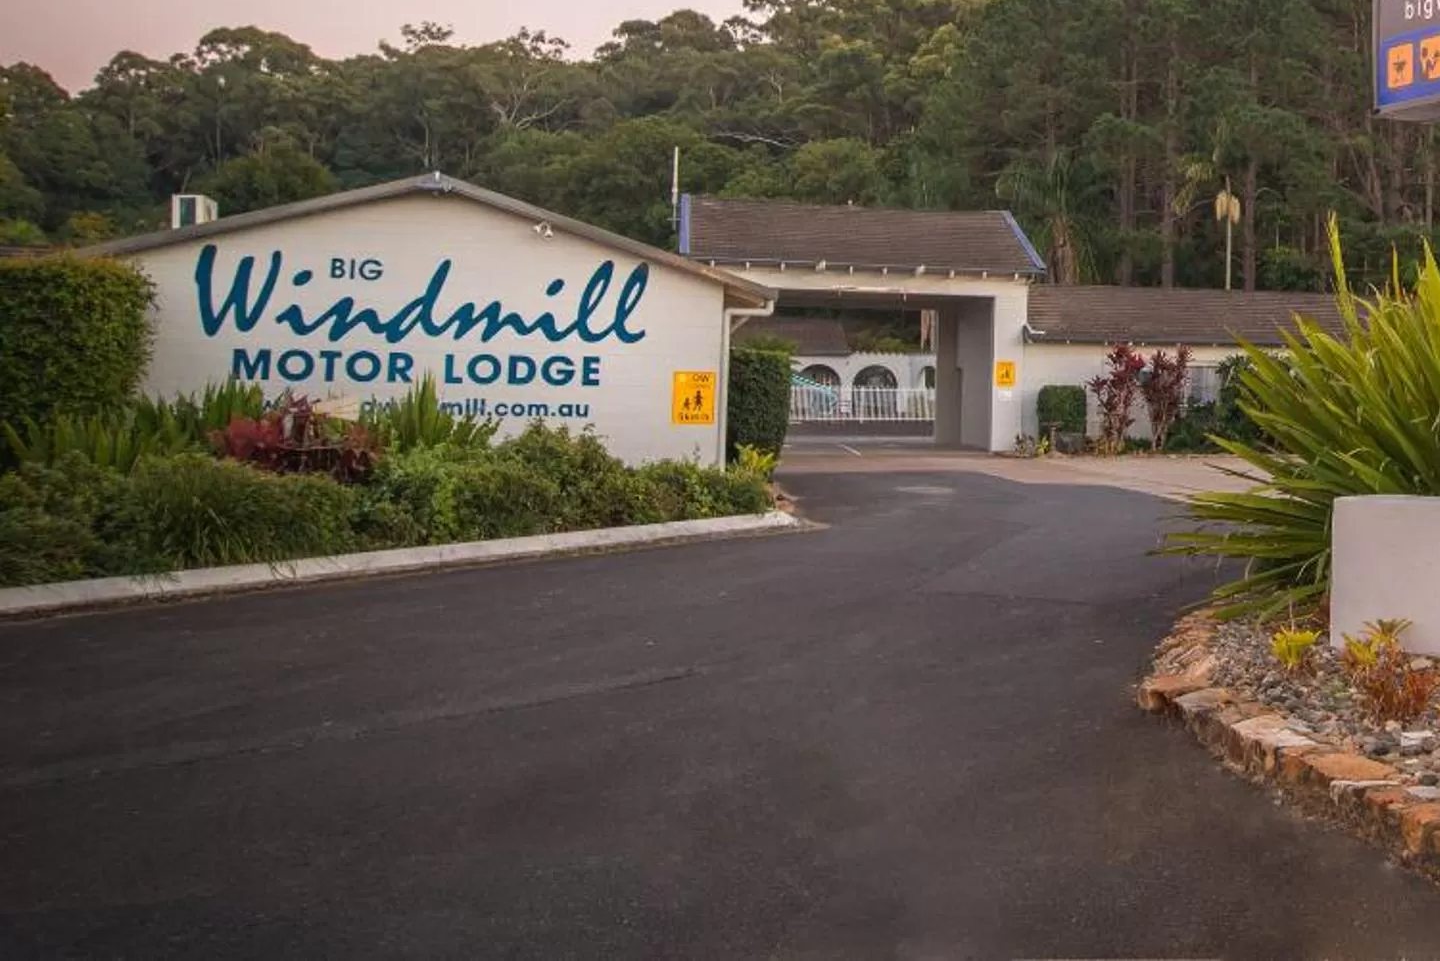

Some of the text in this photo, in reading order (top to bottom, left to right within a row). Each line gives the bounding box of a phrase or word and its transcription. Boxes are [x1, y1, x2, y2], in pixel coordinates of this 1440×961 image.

[330, 258, 384, 281] BIG
[195, 244, 650, 343] Windmill
[232, 349, 601, 386] MOTOR LODGE
